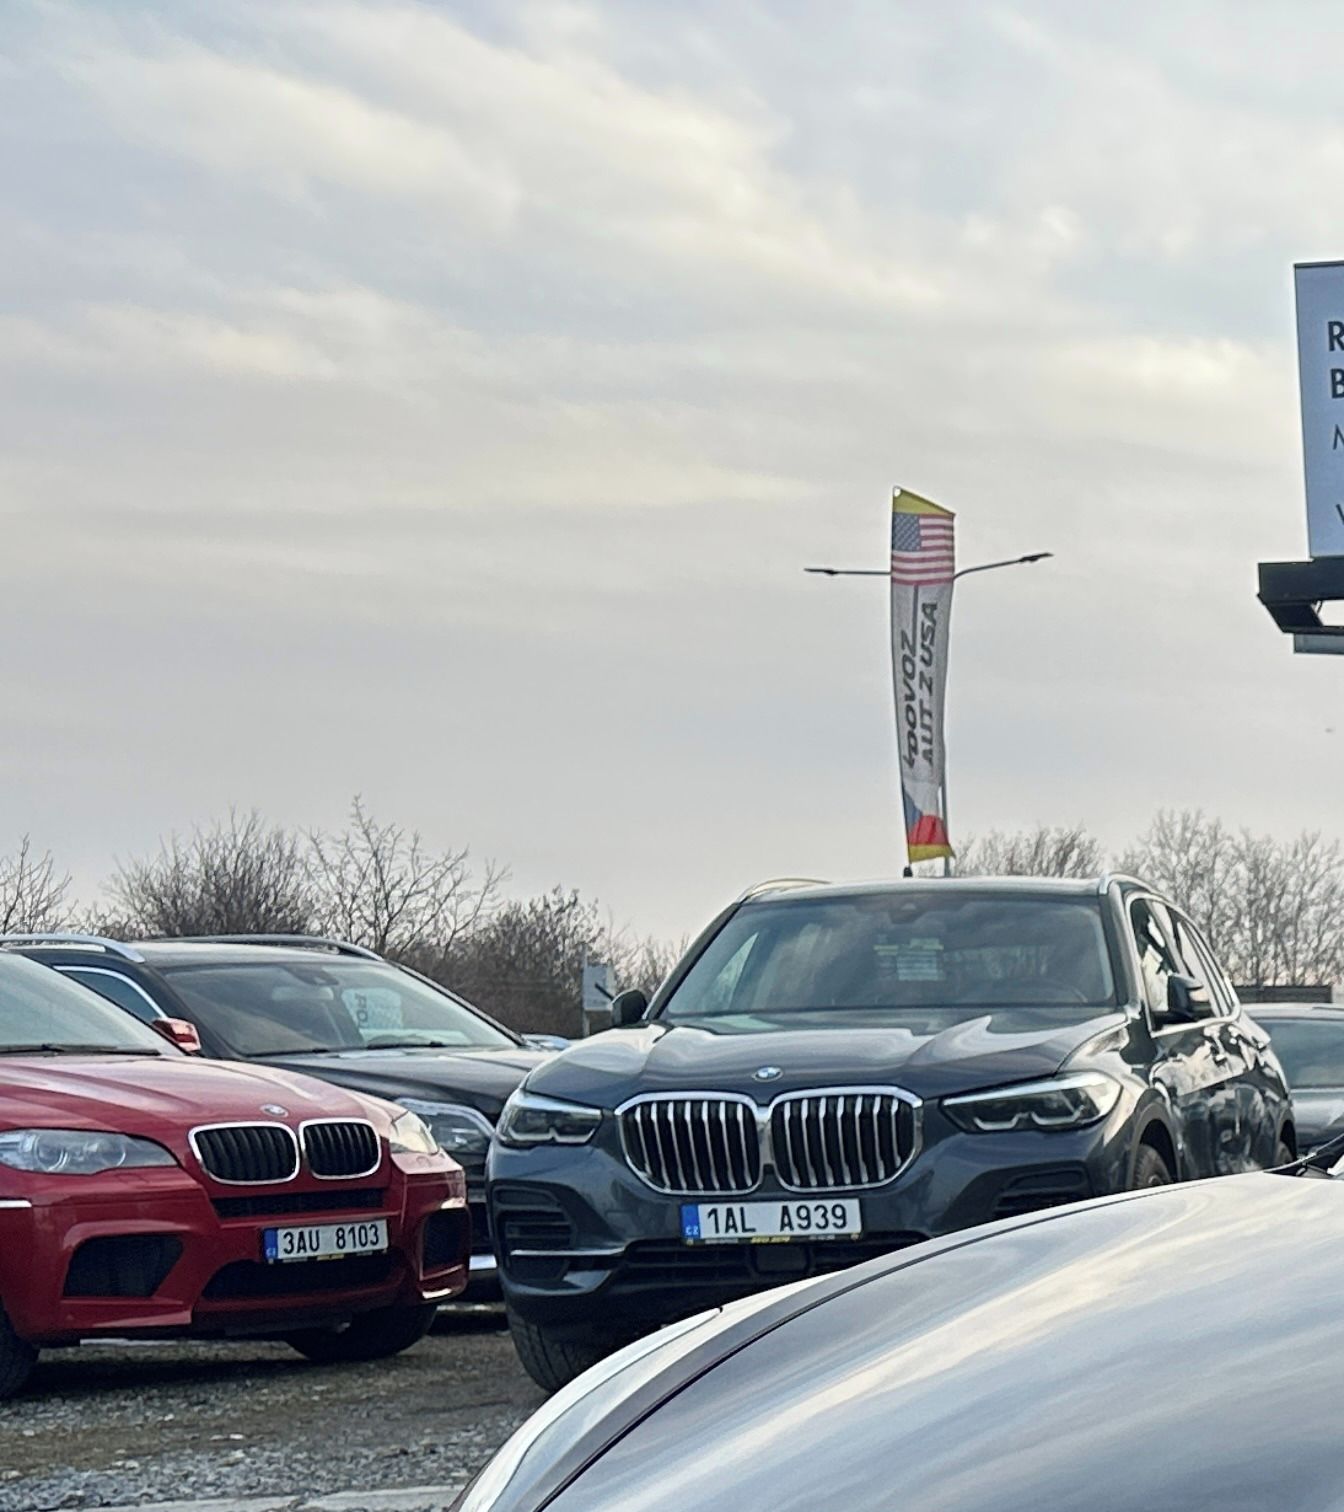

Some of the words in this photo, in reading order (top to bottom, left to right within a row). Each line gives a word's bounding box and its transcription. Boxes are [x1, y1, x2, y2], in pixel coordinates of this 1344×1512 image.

[920, 602, 938, 668] USA
[902, 629, 918, 769] DOVOZ
[919, 671, 933, 697] Z
[919, 698, 933, 768] AUT
[283, 1229, 320, 1254] 3AU
[335, 1224, 380, 1250] 8103
[707, 1206, 756, 1234] 1AL
[779, 1203, 847, 1233] A939
